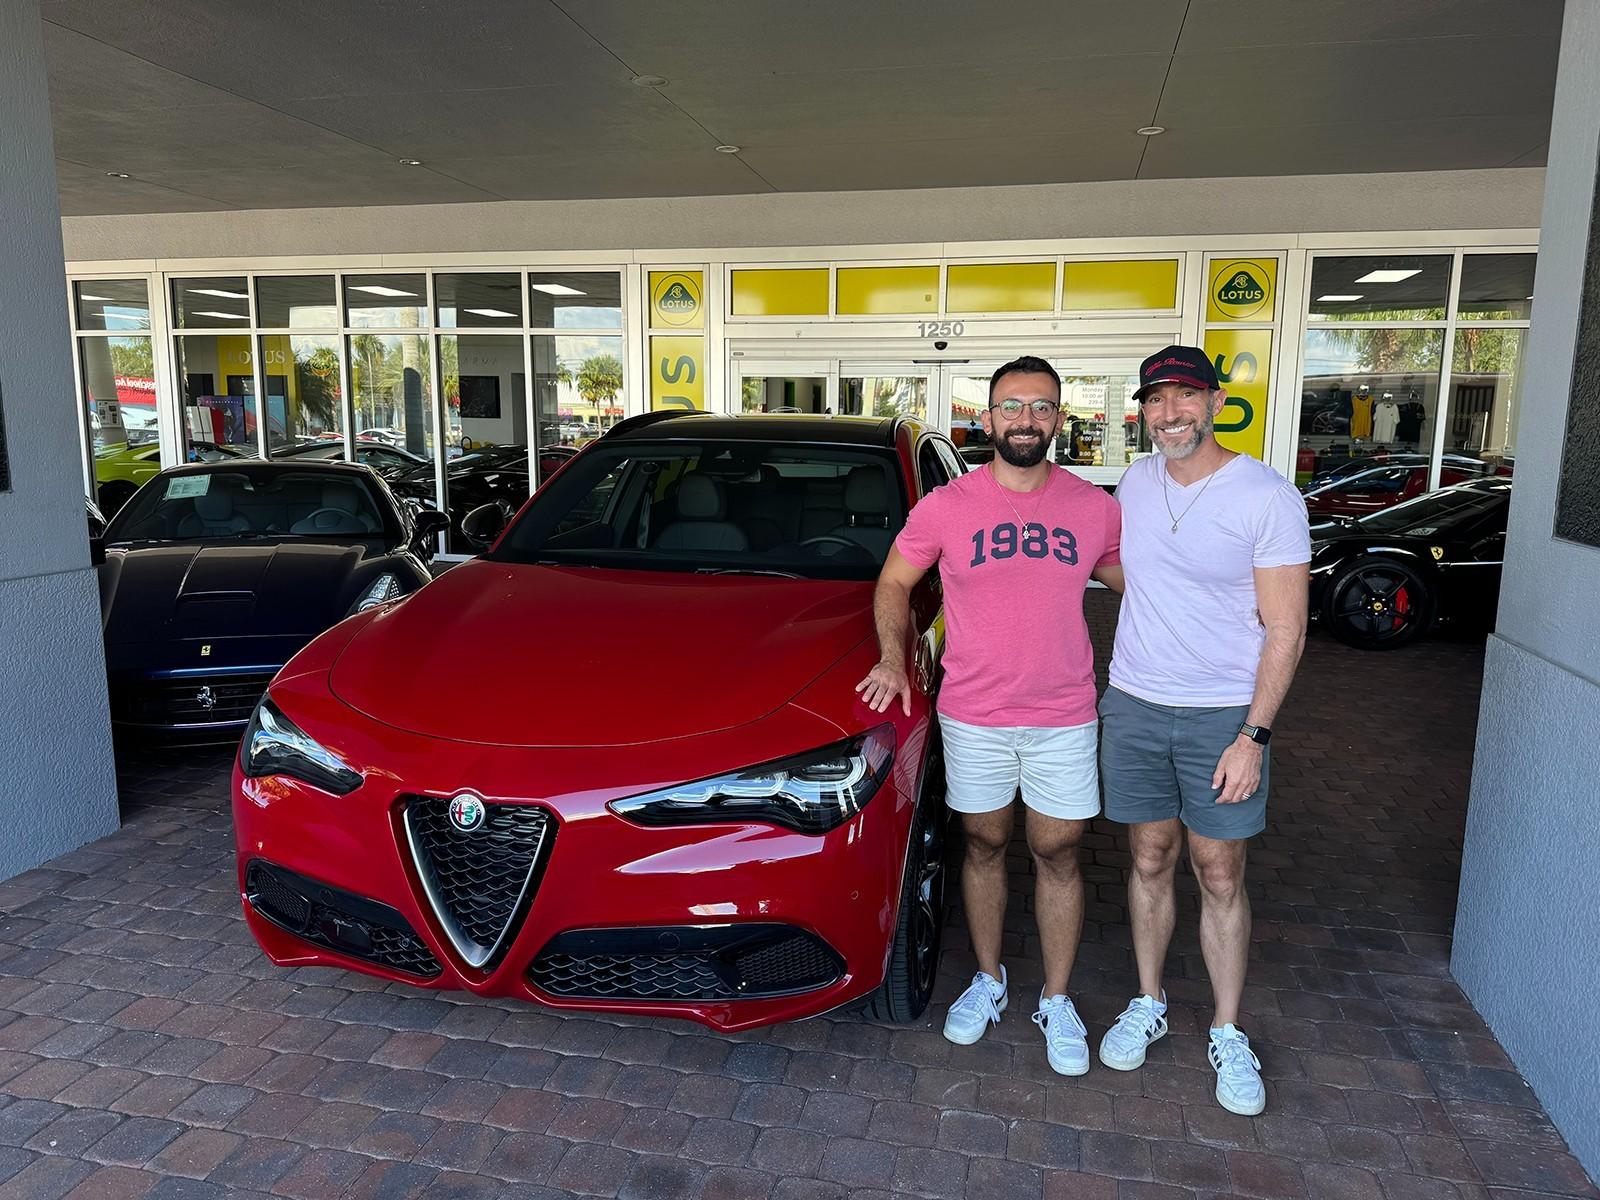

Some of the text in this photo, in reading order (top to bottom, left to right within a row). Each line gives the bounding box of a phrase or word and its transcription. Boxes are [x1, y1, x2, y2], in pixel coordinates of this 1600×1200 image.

[1221, 290, 1262, 300] LOTUS
[661, 300, 694, 309] LOTUS
[918, 321, 964, 338] 1250
[970, 522, 1079, 568] 1983
